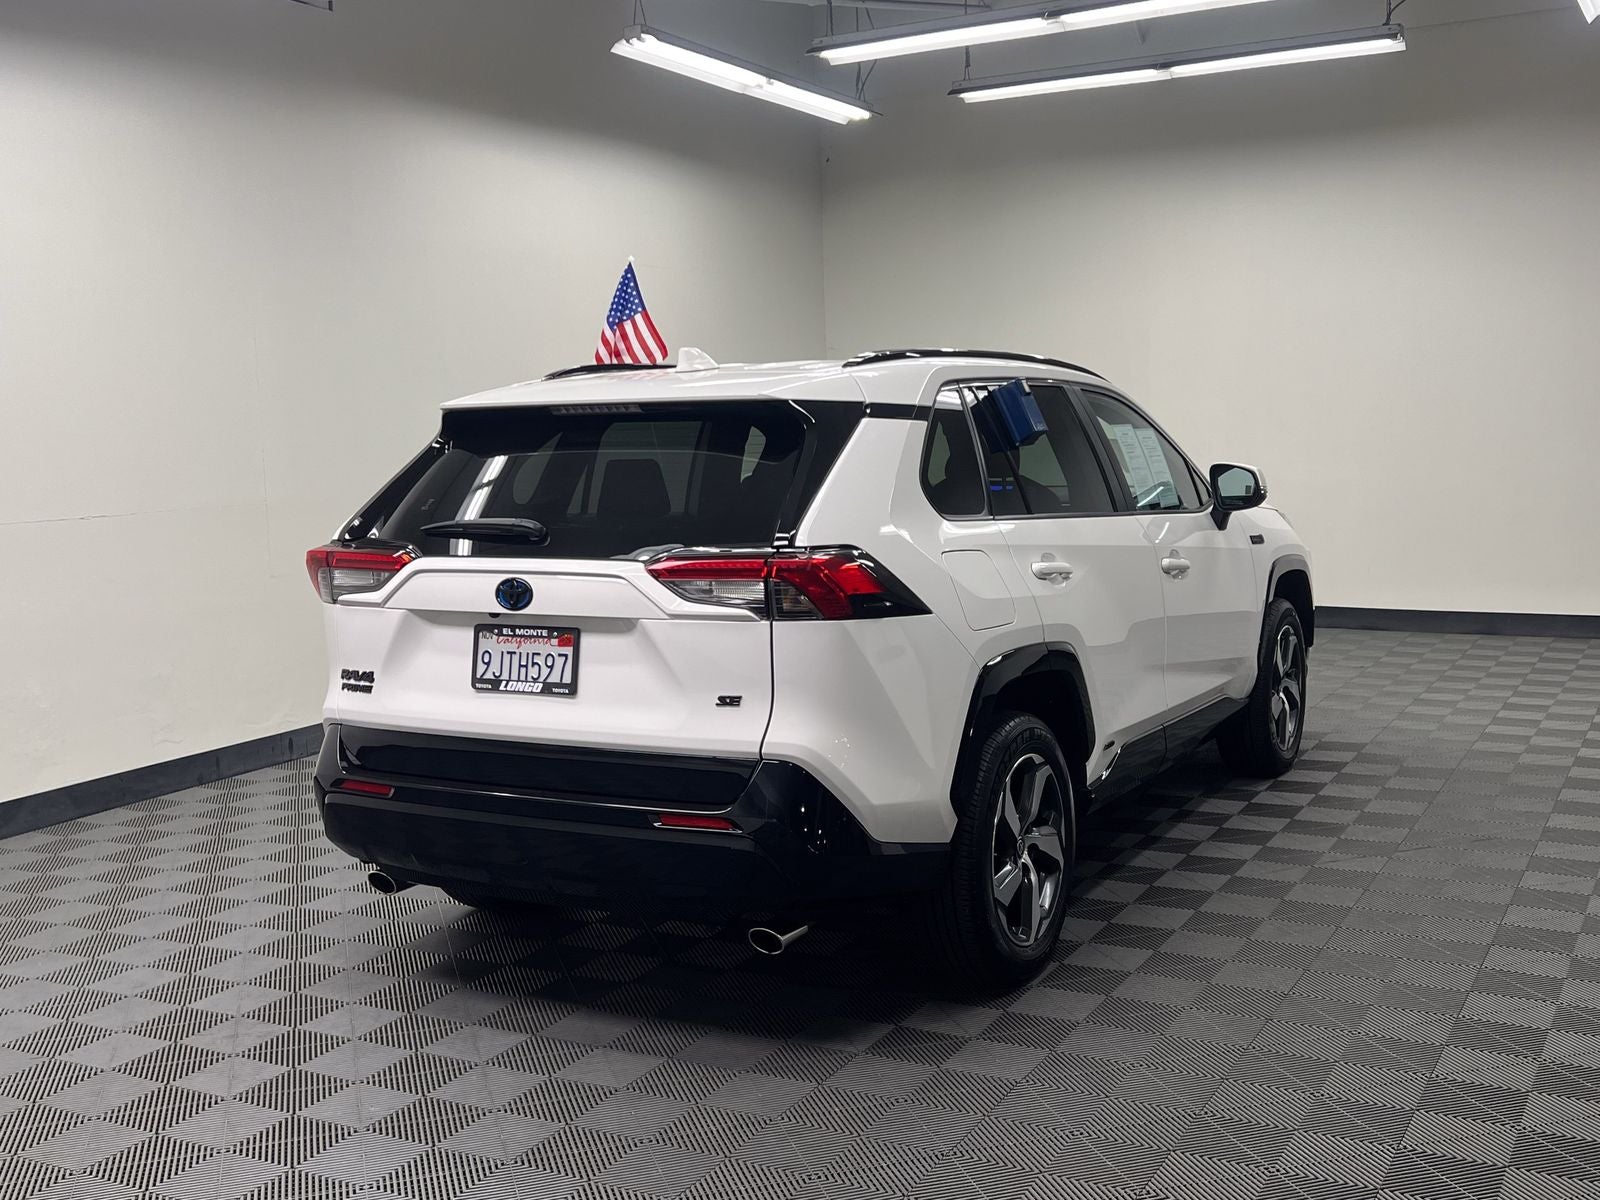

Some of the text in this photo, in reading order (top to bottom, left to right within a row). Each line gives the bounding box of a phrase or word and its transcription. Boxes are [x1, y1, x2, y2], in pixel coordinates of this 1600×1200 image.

[515, 628, 548, 636] MONTE
[480, 650, 568, 682] 9JTH597
[499, 680, 543, 692] LONGO
[716, 696, 742, 706] SE
